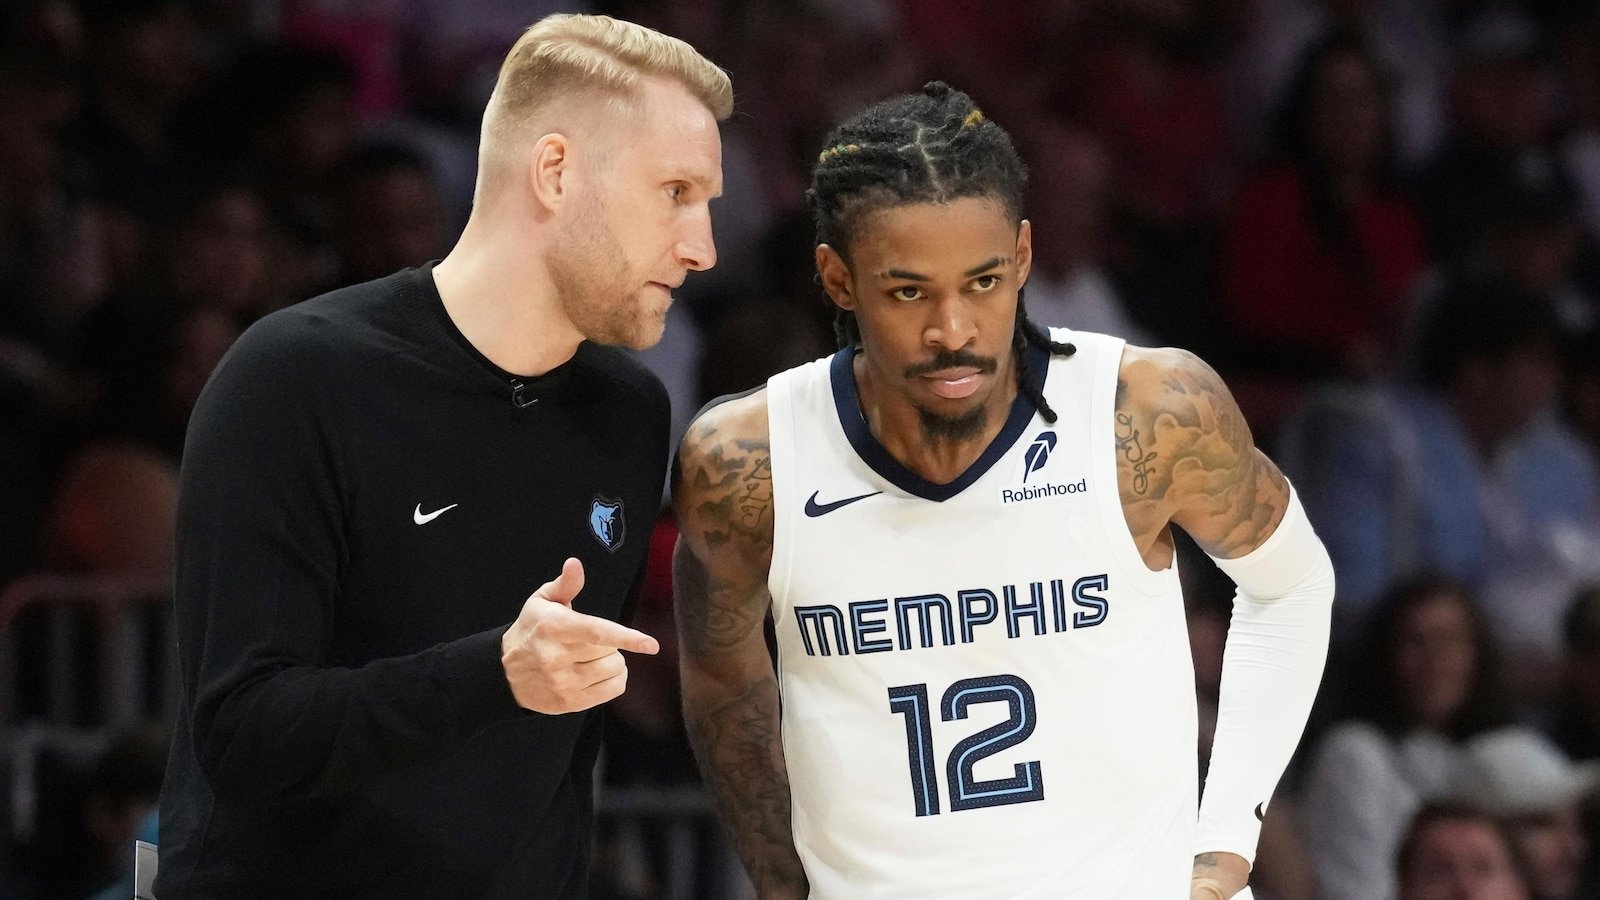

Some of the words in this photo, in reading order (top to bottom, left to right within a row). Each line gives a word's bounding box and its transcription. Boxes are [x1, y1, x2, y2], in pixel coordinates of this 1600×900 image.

[1002, 478, 1087, 503] Robinhood
[794, 574, 1109, 656] MEMPHIS
[888, 674, 1045, 817] 12
